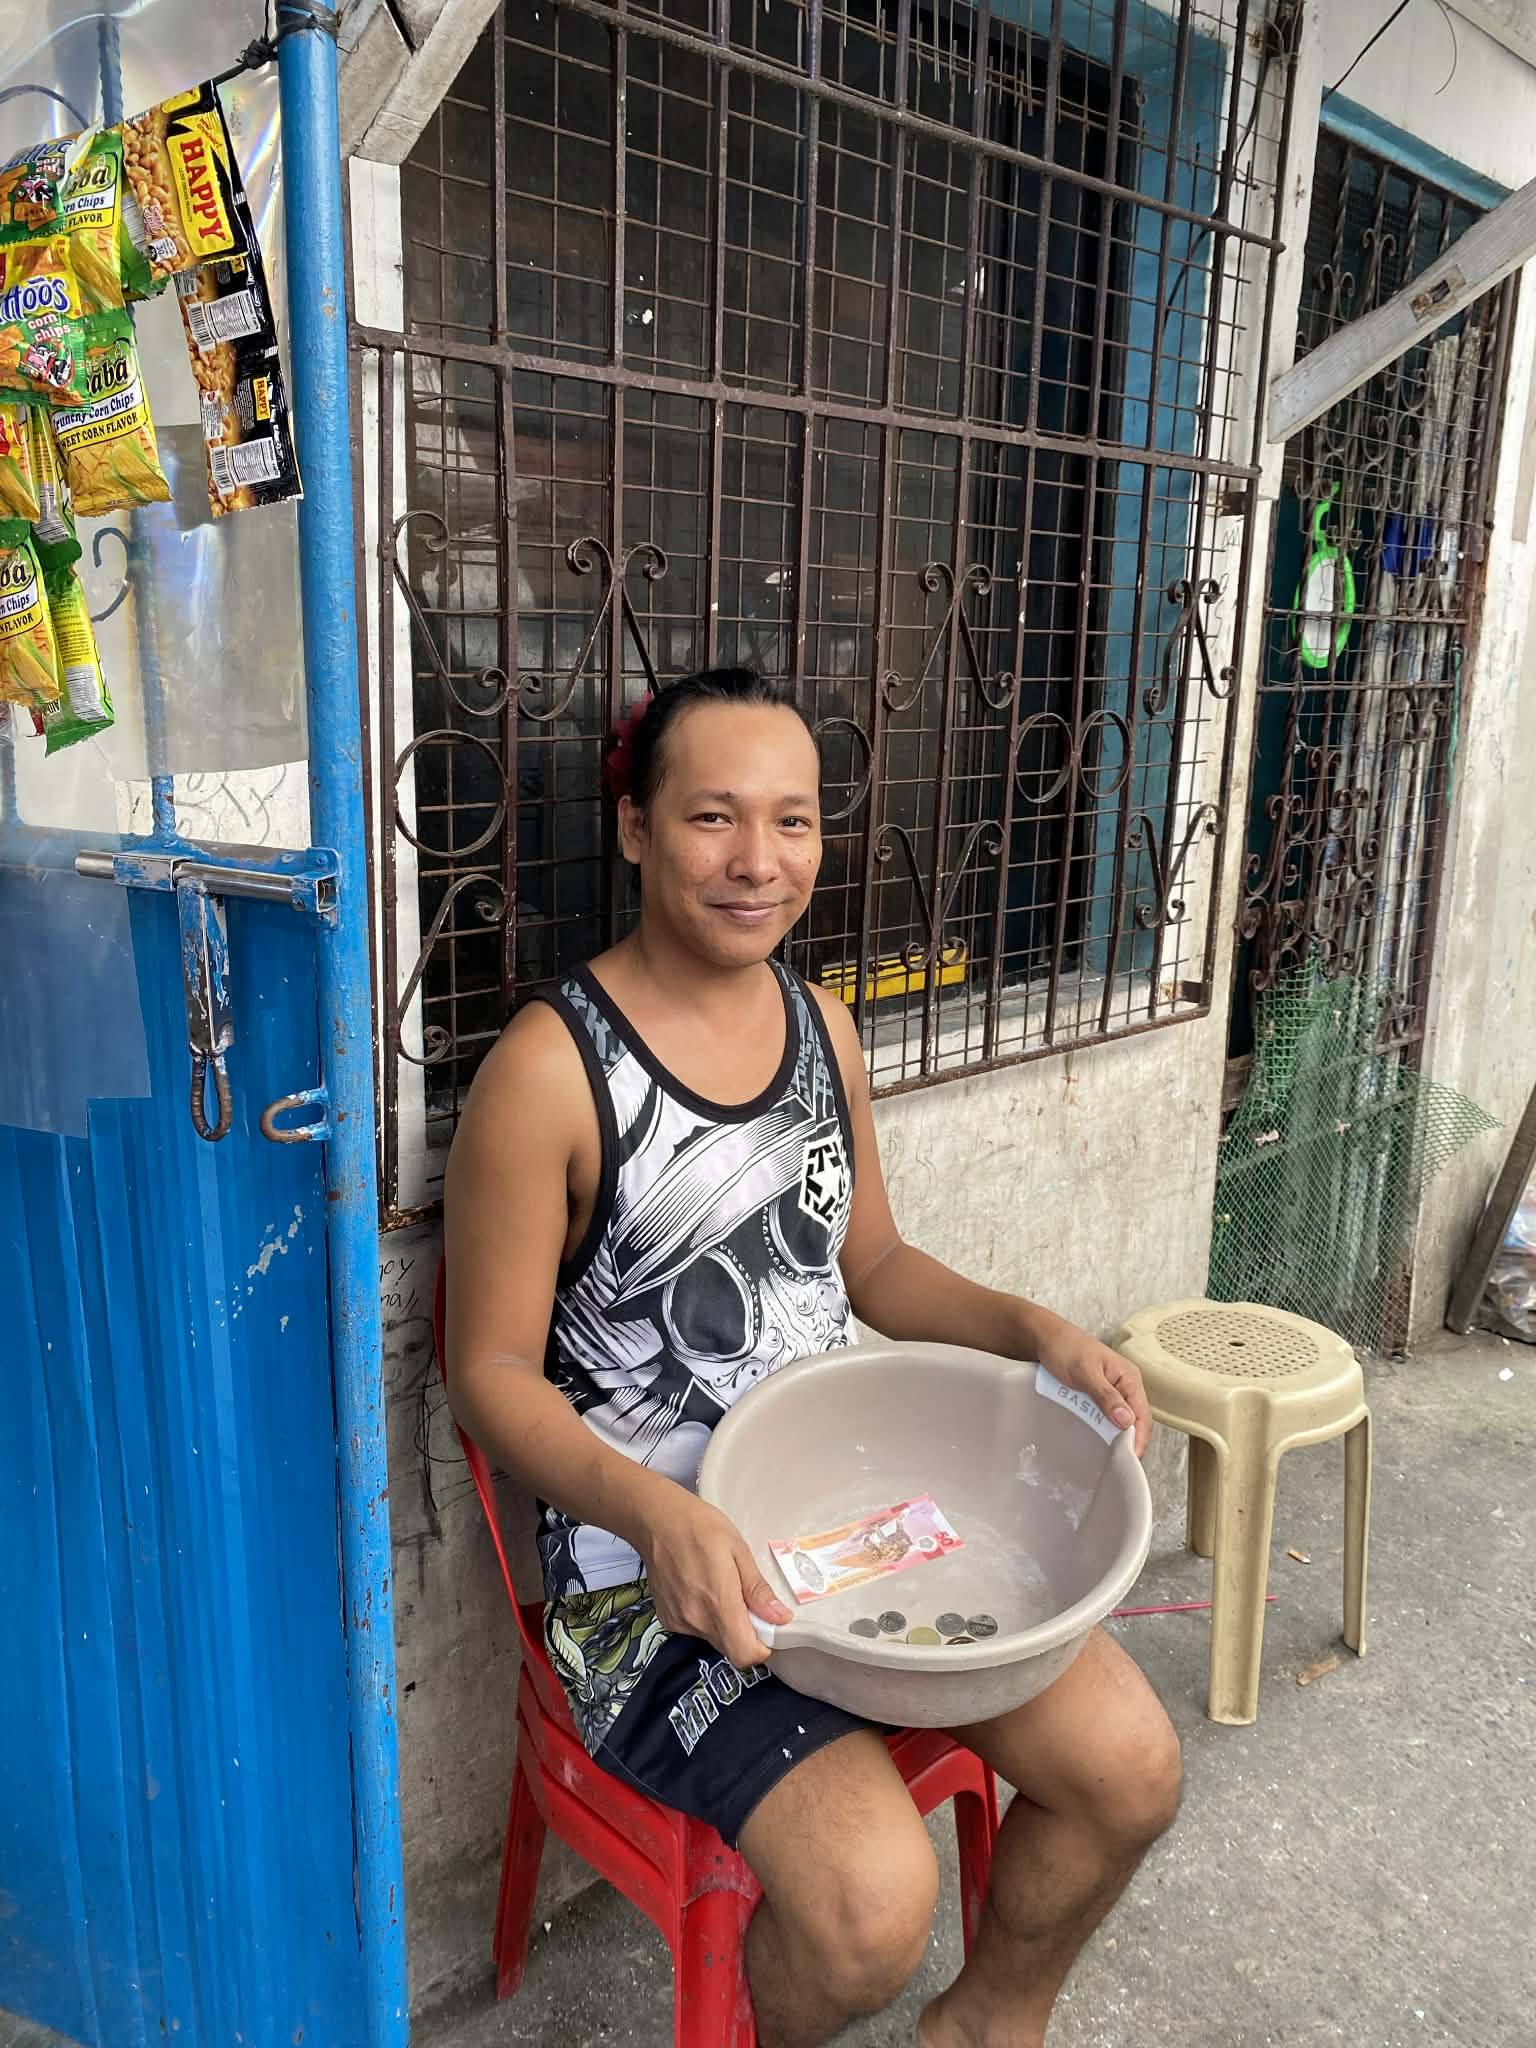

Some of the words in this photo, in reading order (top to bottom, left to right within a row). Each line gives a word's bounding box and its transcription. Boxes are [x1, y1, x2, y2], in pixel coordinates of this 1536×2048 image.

[180, 137, 226, 240] HAPPY
[77, 196, 105, 210] Chips
[69, 213, 102, 228] FLAVOR
[0, 277, 69, 320] ttoos
[28, 313, 58, 329] corn
[35, 324, 71, 342] chips
[87, 358, 128, 394] aba
[110, 392, 134, 411] Chips
[82, 425, 106, 441] CORN
[106, 412, 138, 434] FLAVOR
[6, 593, 30, 611] Chips
[1057, 1386, 1105, 1425] BASIN
